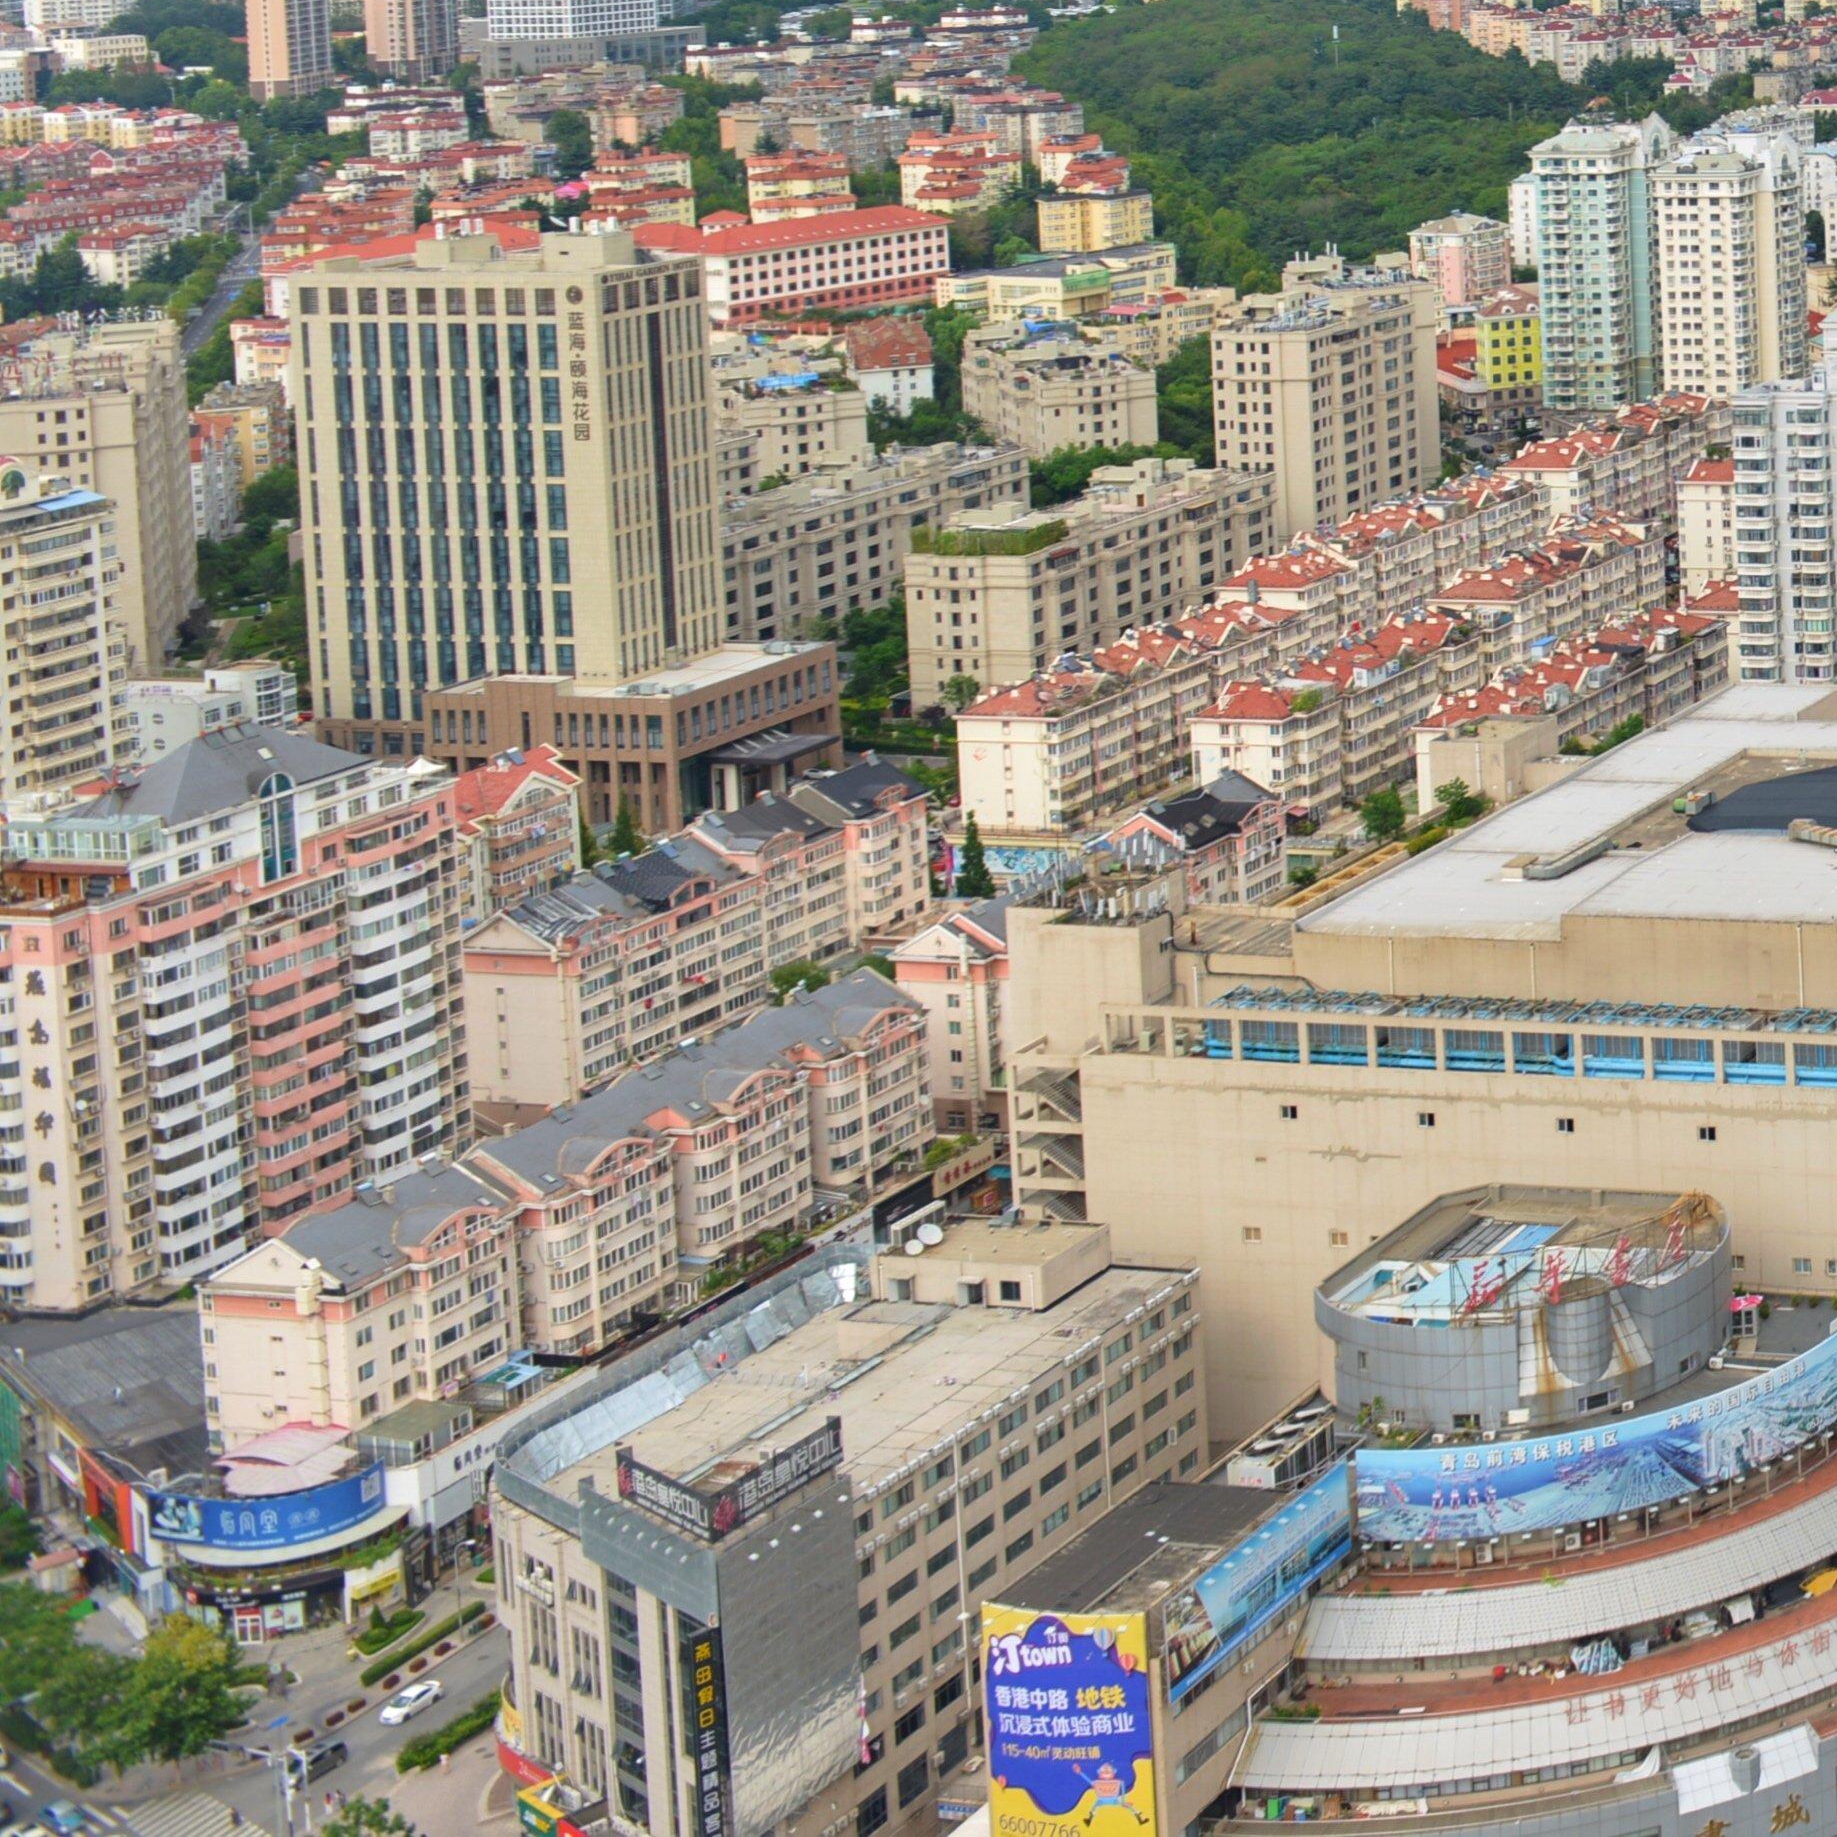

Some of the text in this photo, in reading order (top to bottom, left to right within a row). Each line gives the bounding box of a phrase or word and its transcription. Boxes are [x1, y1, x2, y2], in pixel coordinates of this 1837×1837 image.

[1440, 1430, 1619, 1472] 青岛前湾保税港区
[1020, 1644, 1072, 1668] town
[995, 1684, 1128, 1711] 香港中路 地铁
[998, 1712, 1135, 1738] 沉浸式体验商业
[999, 1813, 1081, 1837] 66007766
